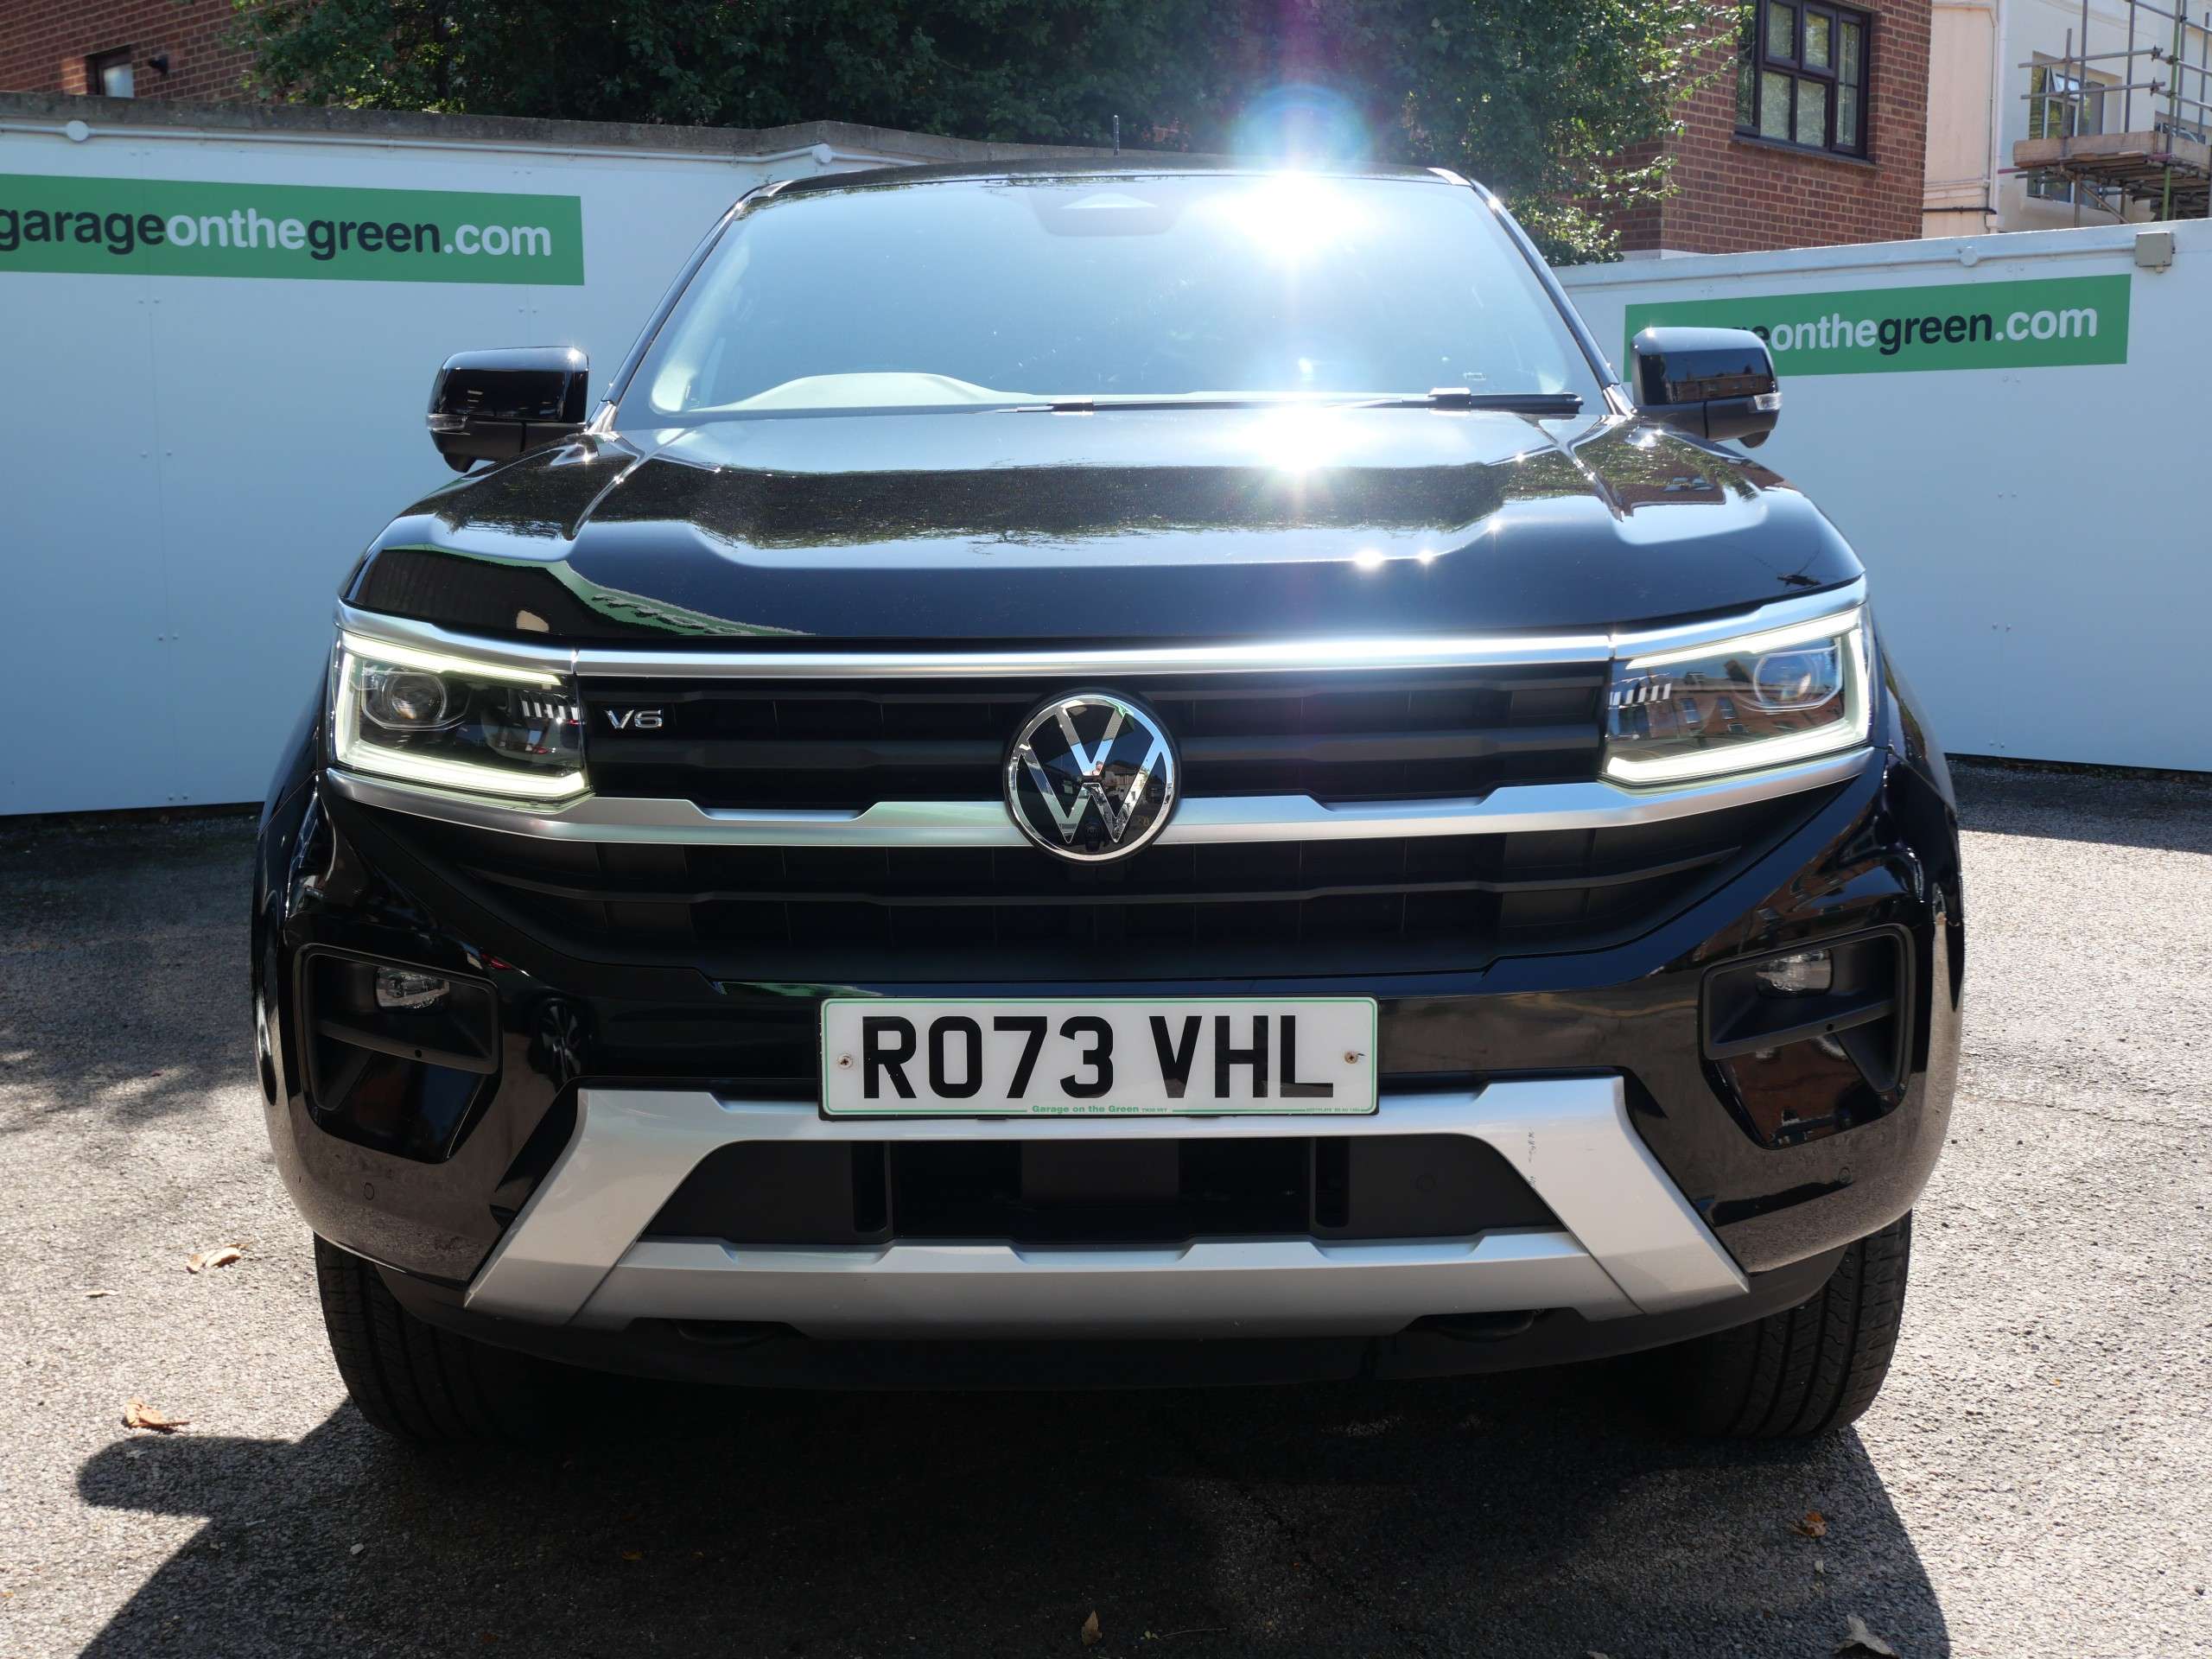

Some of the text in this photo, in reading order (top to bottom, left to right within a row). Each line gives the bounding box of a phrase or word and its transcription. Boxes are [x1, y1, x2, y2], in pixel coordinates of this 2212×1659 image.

[0, 207, 552, 261] garageonthegreen.com
[604, 708, 664, 729] V6
[861, 1014, 1334, 1099] RO73 VHL
[1032, 1105, 1069, 1114] Garage
